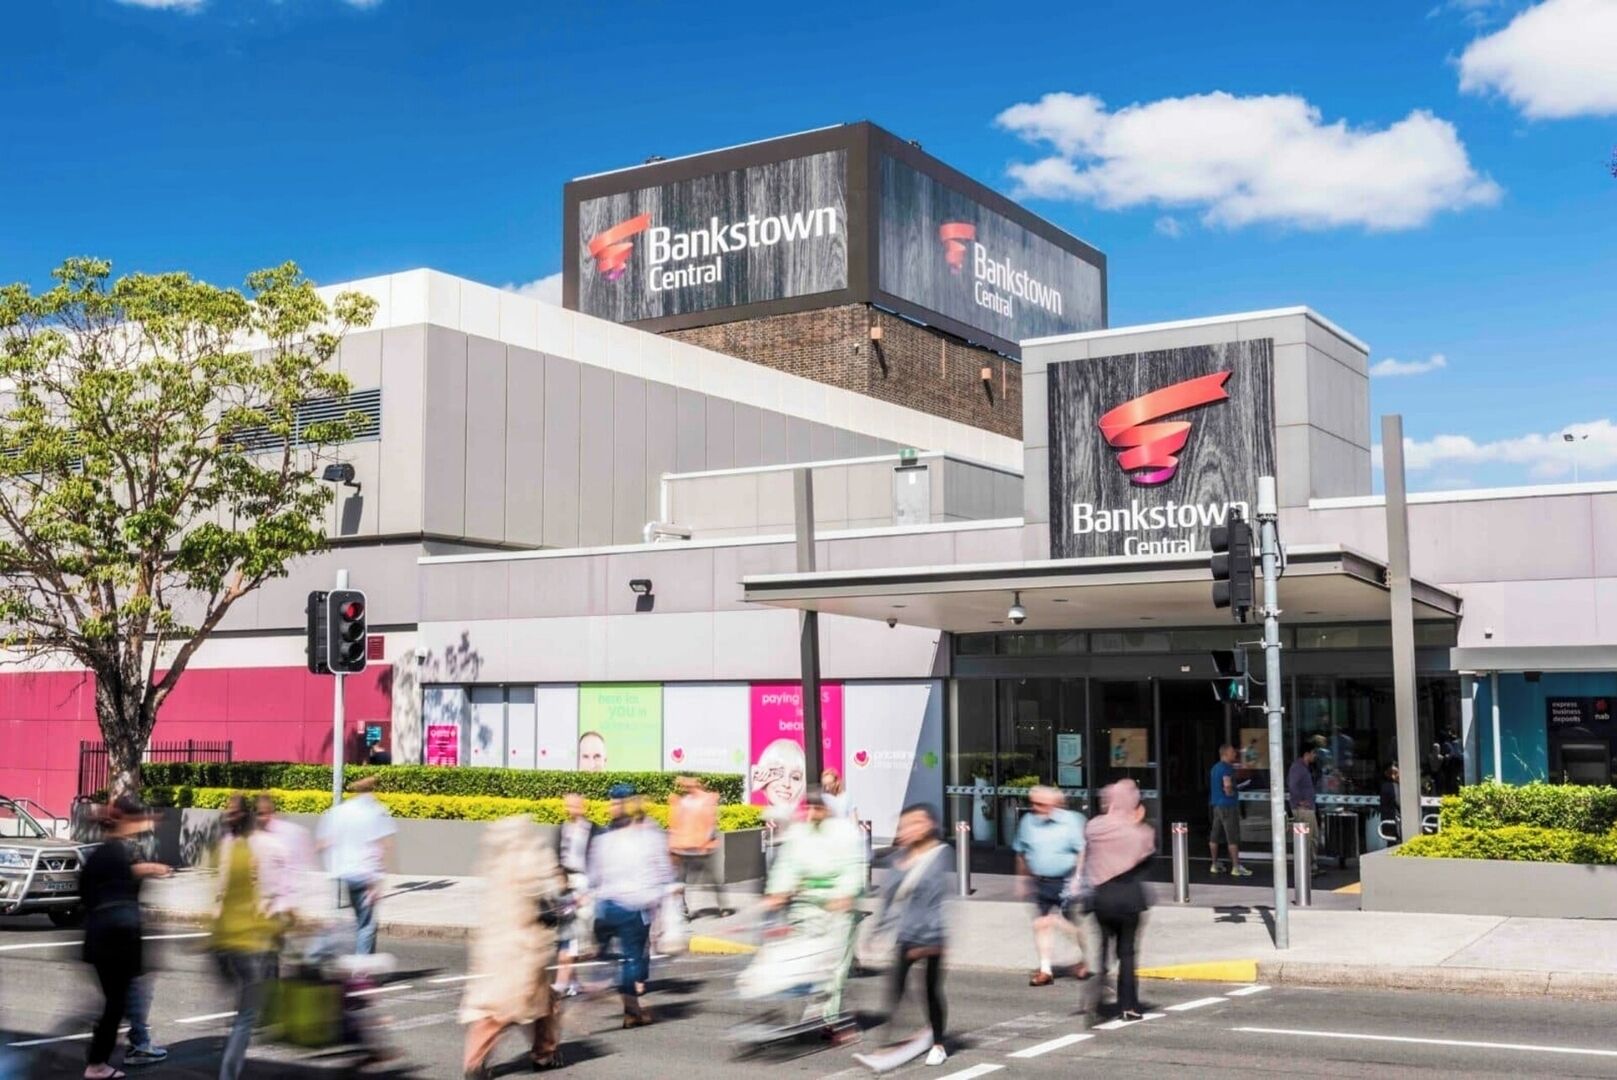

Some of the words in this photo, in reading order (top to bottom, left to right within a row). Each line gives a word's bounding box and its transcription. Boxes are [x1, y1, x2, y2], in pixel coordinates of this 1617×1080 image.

[650, 206, 837, 265] Bankstown
[650, 256, 722, 292] Central
[974, 242, 1062, 316] Bankstown
[974, 281, 1013, 319] Central
[1073, 500, 1249, 535] Bankstown
[1124, 533, 1196, 556] Central
[761, 692, 800, 706] paying
[1552, 708, 1581, 716] business
[1552, 716, 1581, 724] deposits
[1594, 712, 1610, 721] nab
